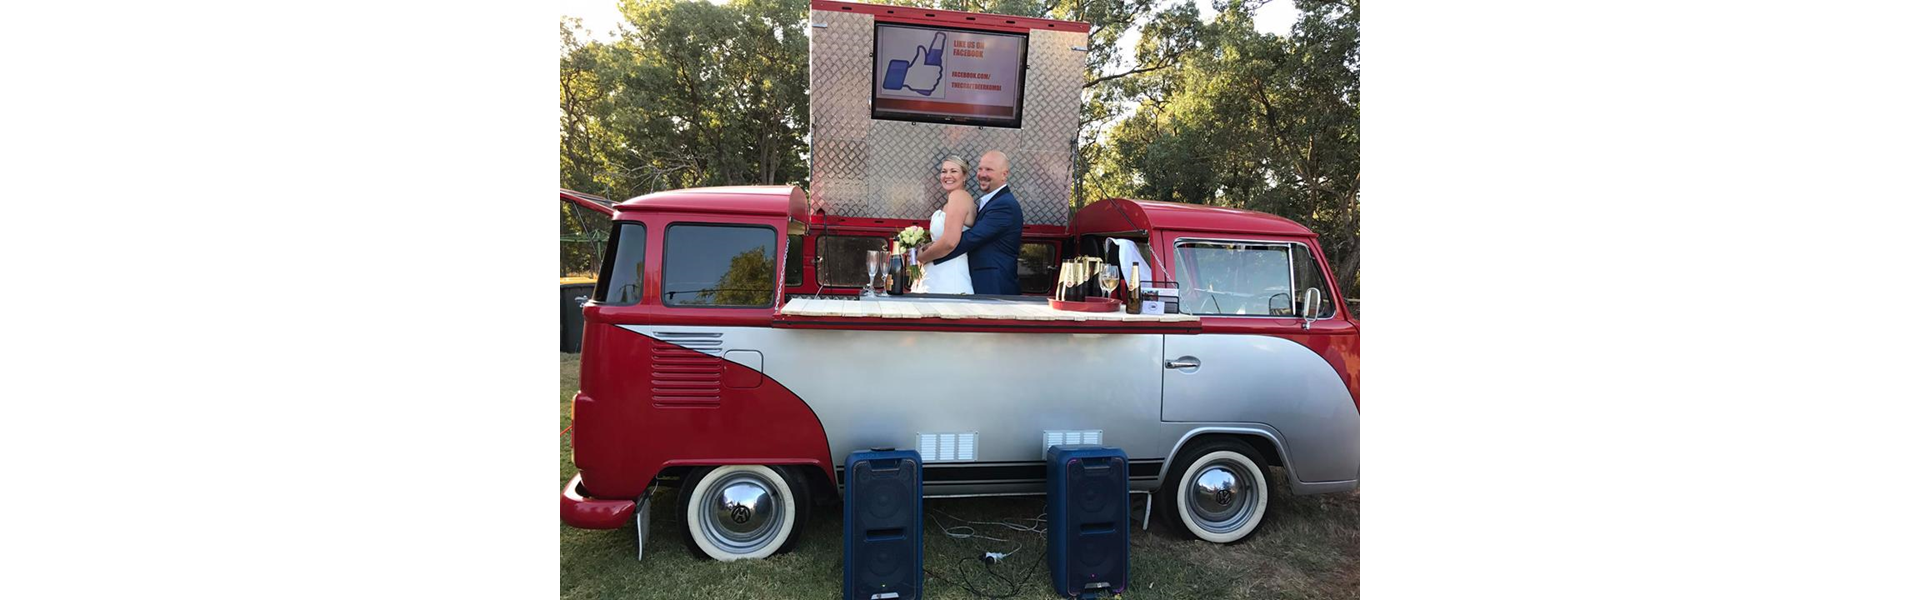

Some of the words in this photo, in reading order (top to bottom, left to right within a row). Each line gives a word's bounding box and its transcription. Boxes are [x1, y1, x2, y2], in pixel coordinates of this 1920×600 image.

[954, 40, 966, 48] LIKE
[967, 41, 975, 49] US
[953, 49, 983, 58] FACEBOOK
[952, 71, 991, 79] FACEBOOK.COM/
